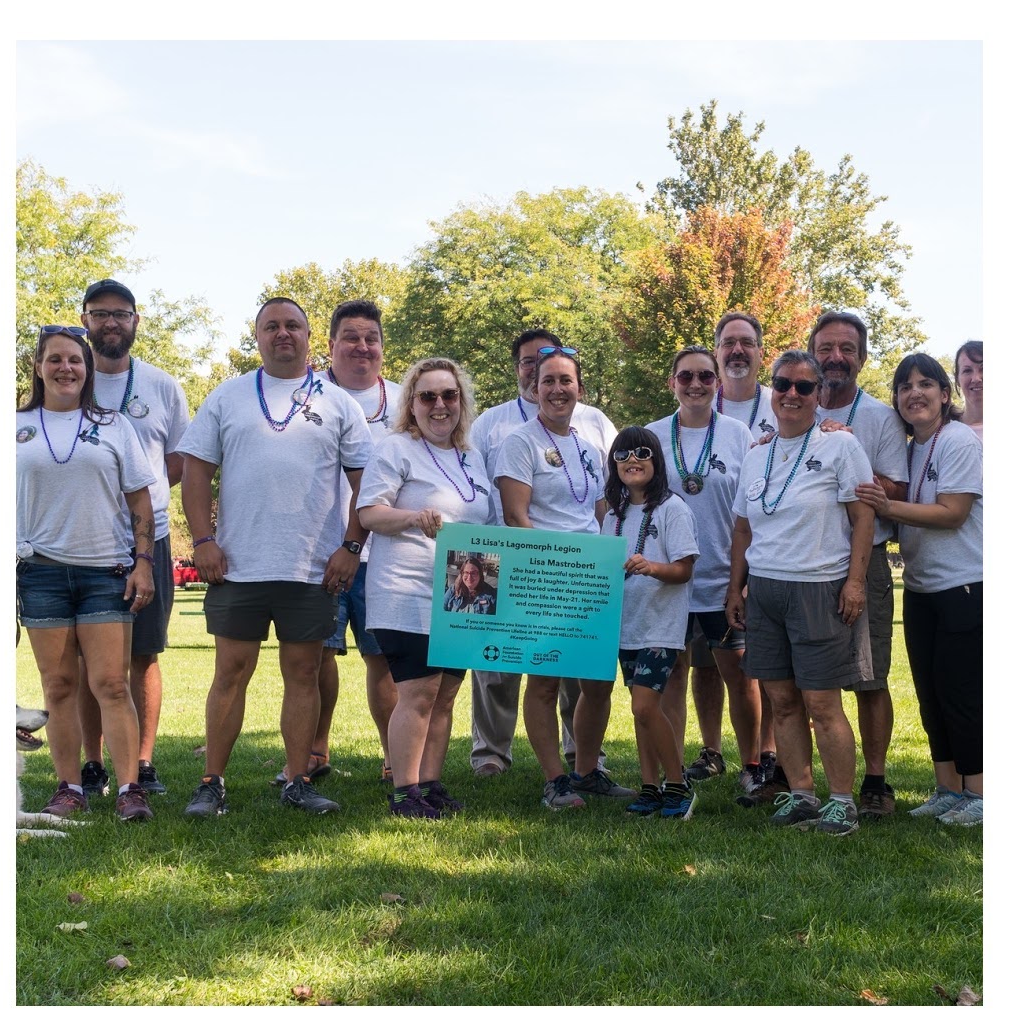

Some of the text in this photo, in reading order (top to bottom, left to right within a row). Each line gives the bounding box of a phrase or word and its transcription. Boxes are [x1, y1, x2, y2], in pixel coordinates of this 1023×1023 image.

[482, 538, 505, 547] Lisa's
[506, 540, 552, 552] Lagomorph
[554, 544, 582, 554] Legion
[529, 558, 596, 570] Lisa Mastroberti
[570, 580, 611, 590] Unfortunately
[527, 602, 562, 610] compassion
[564, 611, 590, 620] touched.
